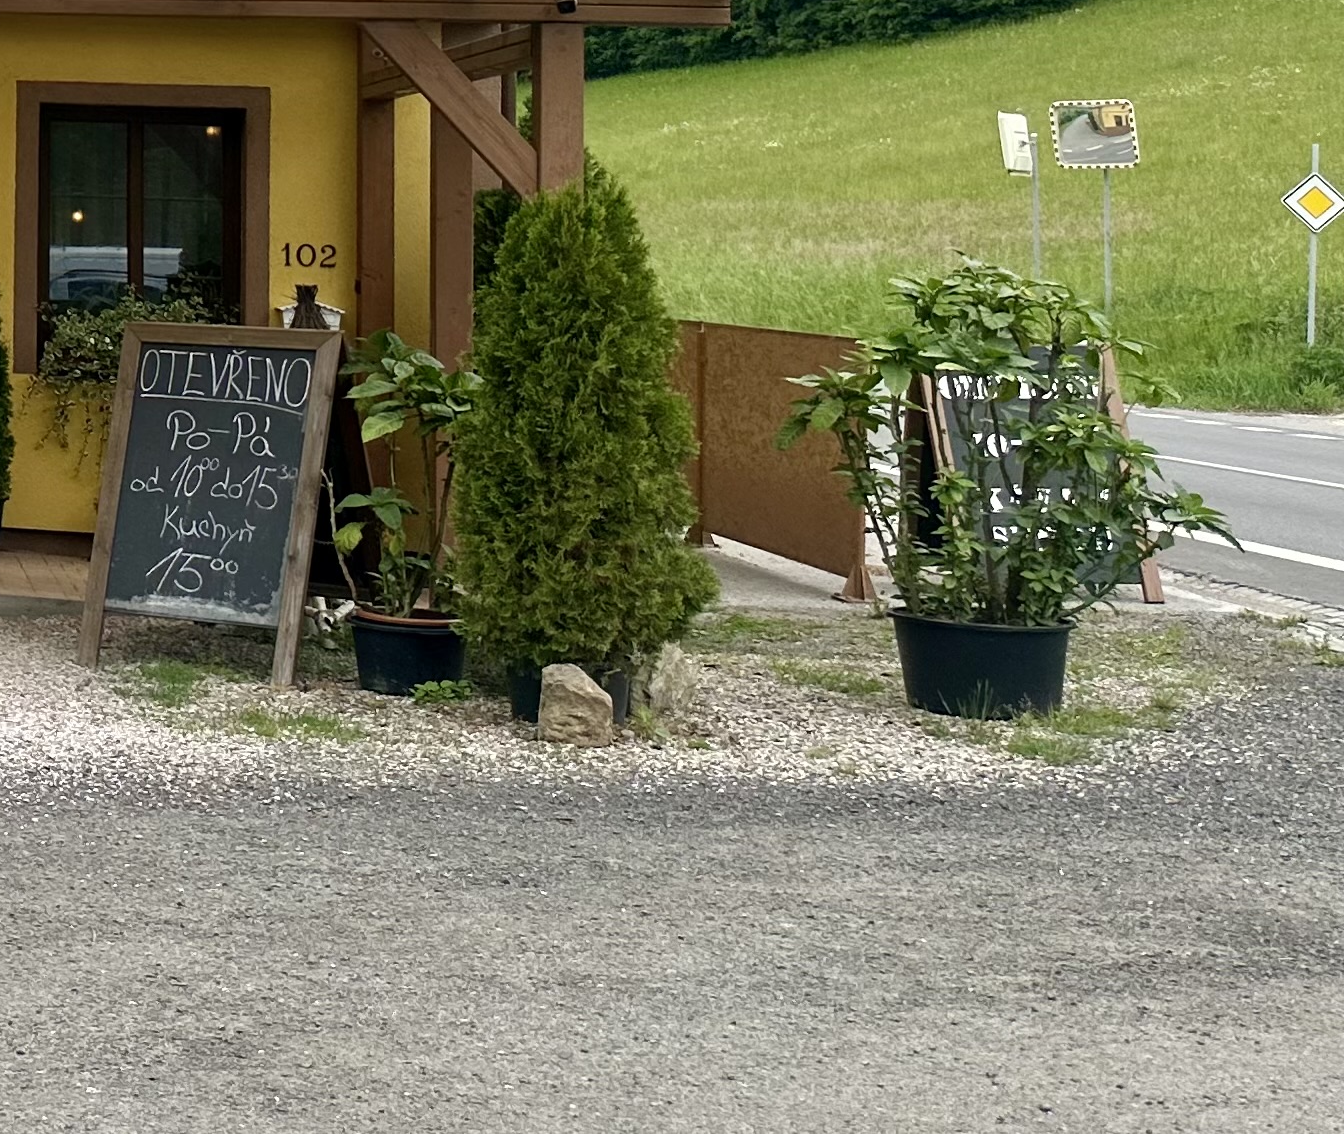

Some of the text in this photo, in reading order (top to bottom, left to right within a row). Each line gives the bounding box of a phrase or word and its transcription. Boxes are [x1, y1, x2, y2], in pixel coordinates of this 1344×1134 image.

[280, 242, 337, 268] 102
[140, 348, 312, 407] OTEVŘENO
[130, 466, 164, 493] od
[210, 467, 242, 499] do
[159, 503, 257, 556] Kuchyň
